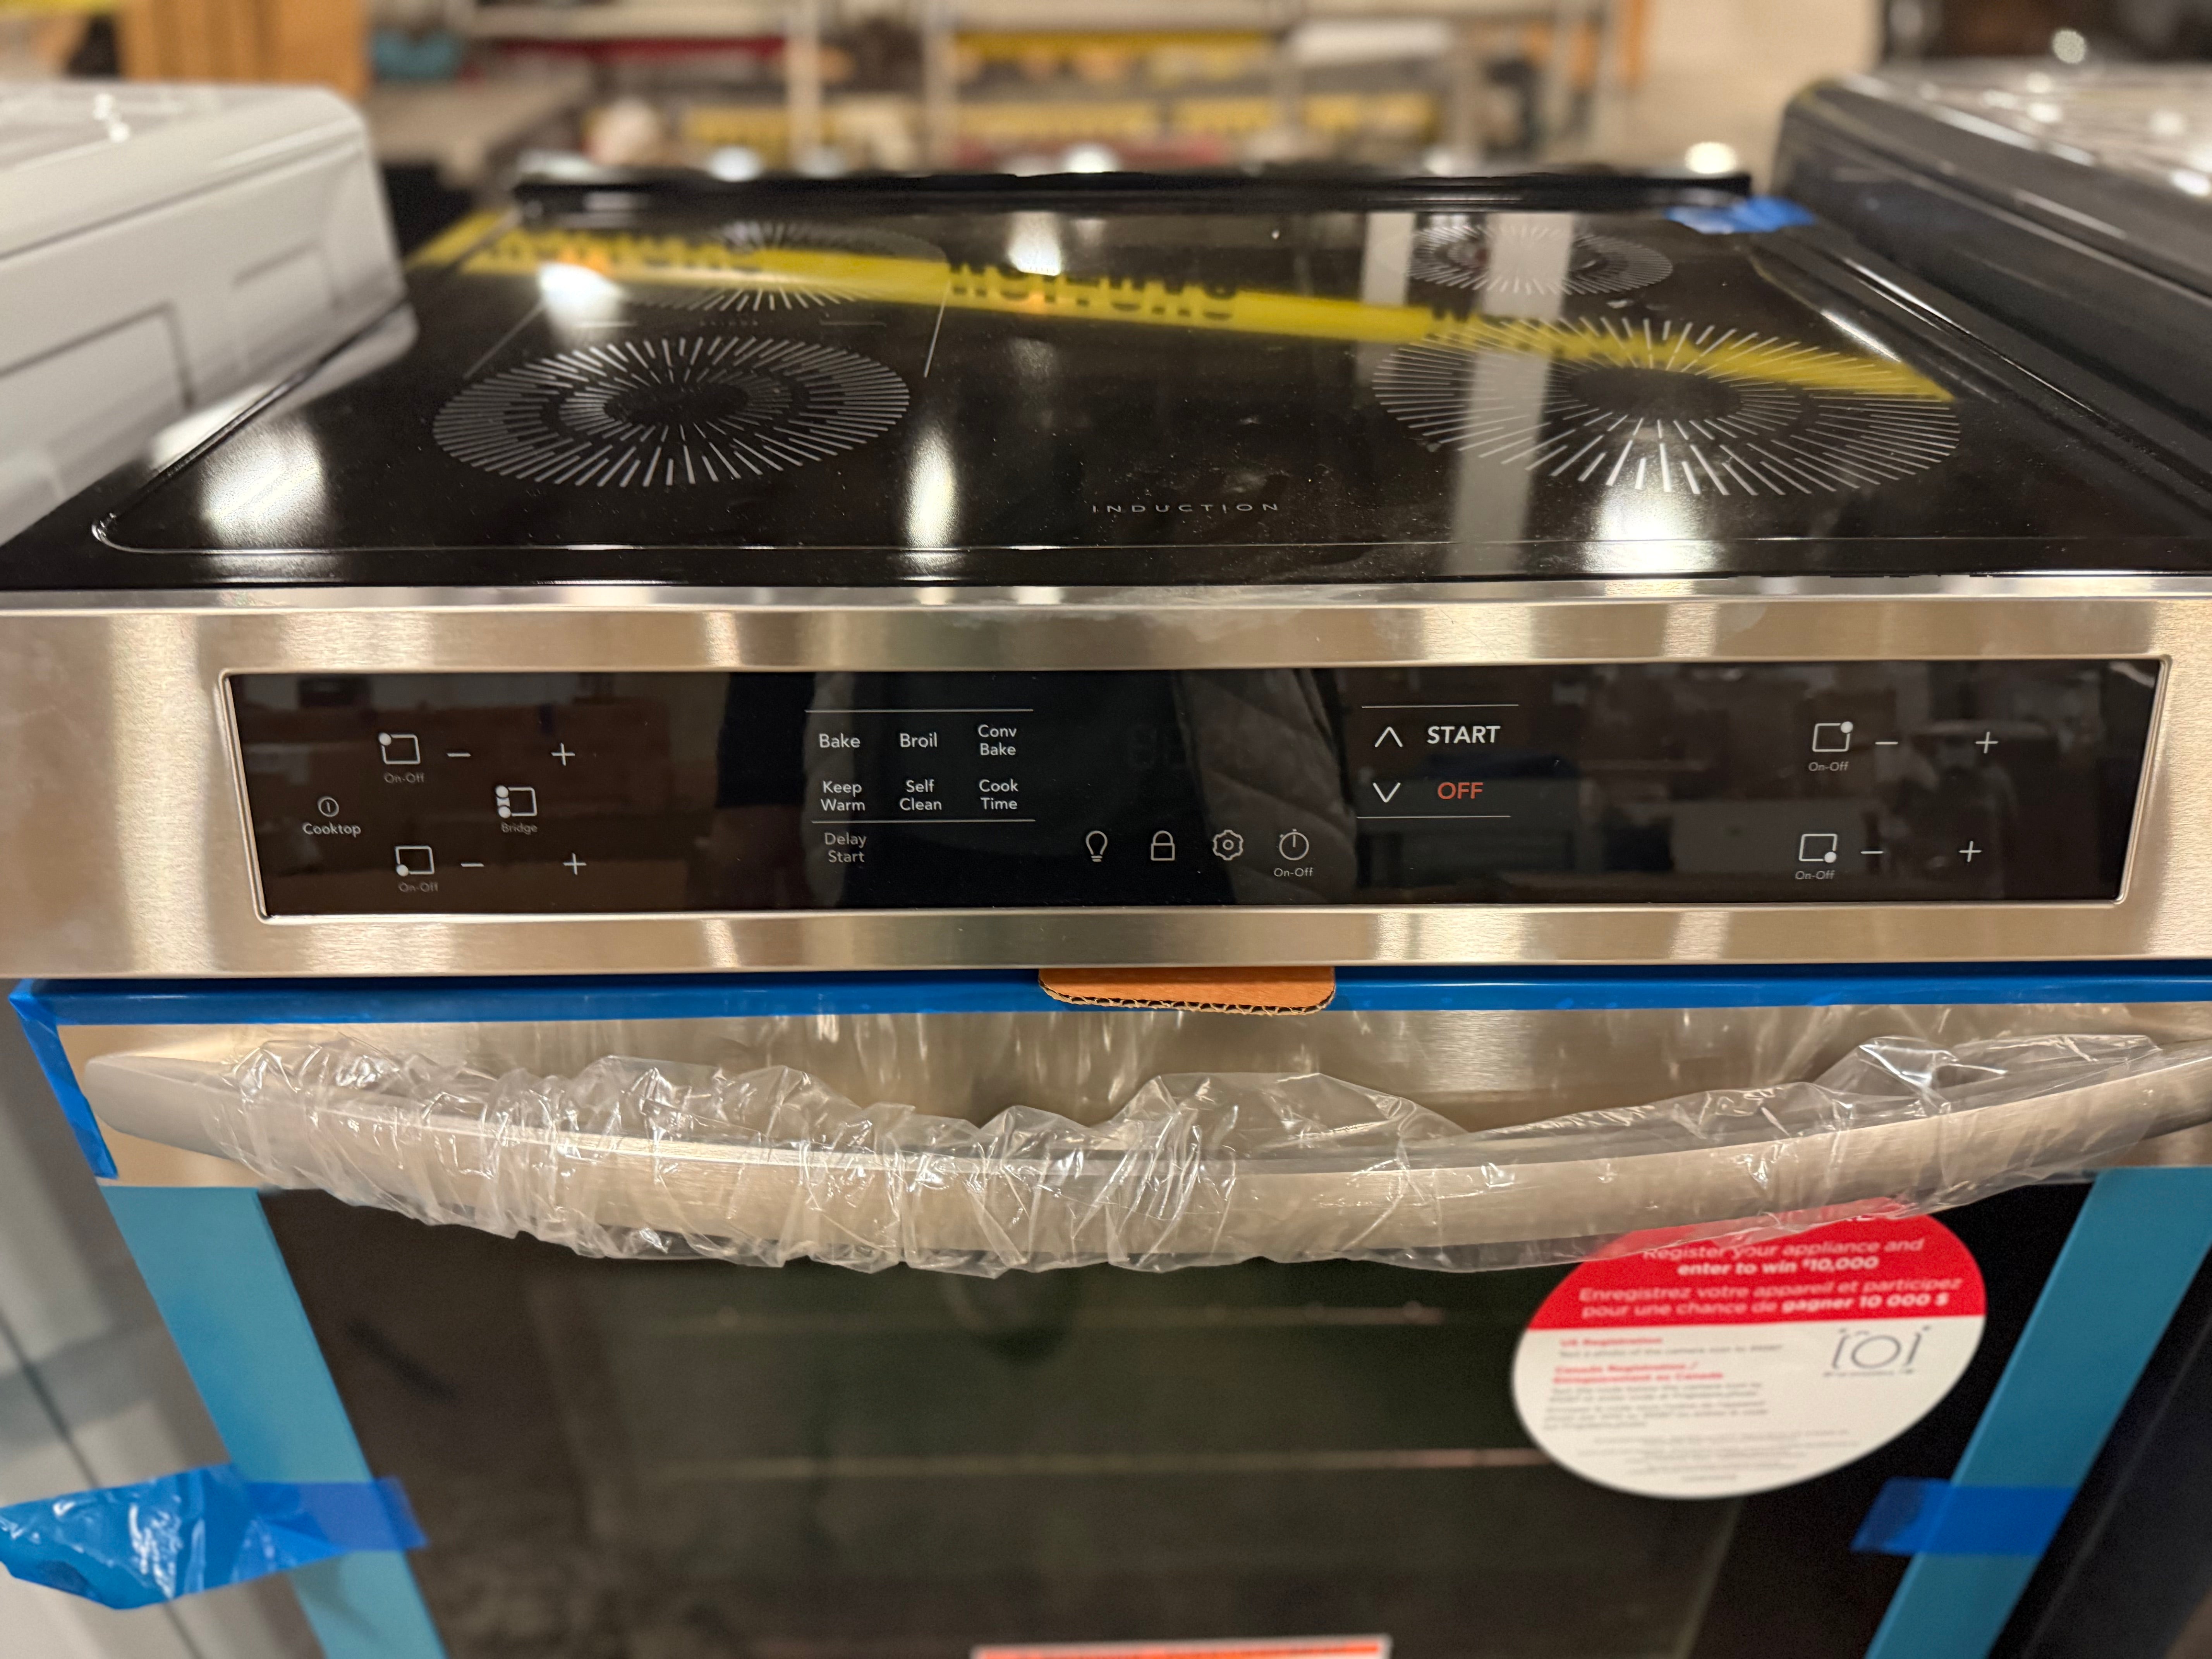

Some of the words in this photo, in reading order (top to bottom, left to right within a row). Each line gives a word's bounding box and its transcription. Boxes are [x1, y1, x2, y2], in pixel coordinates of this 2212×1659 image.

[1092, 503, 1278, 514] INDUCTION
[977, 724, 1017, 737] Conv
[1427, 725, 1501, 744] START
[819, 733, 861, 748] Bake
[900, 732, 938, 748] Broil
[980, 742, 1016, 756] Bake
[1808, 761, 1849, 772] On-Off
[384, 772, 425, 784] On-Off
[979, 778, 1018, 792] Cook
[823, 780, 862, 797] Keep
[905, 778, 935, 793] Self
[1437, 782, 1484, 800] OFF
[820, 798, 866, 812] Warm
[899, 797, 942, 811] Clean
[981, 797, 1018, 810] Time
[302, 822, 361, 838] Cooktop
[501, 823, 538, 835] Bridge
[824, 832, 867, 848] Delay
[828, 850, 865, 863] Start
[1273, 867, 1314, 878] On-Off
[1795, 870, 1835, 880] On-Off
[398, 882, 438, 893] On-Off
[1731, 1245, 1780, 1259] your
[1783, 1241, 1880, 1256] appliance
[1884, 1238, 1925, 1252] and
[1677, 1263, 1731, 1276] enter
[1735, 1262, 1757, 1275] to
[1762, 1261, 1797, 1274] win
[1579, 1287, 1691, 1302] Enregistrez
[1697, 1286, 1750, 1298] votre
[1753, 1281, 1834, 1297] appareil
[1837, 1281, 1858, 1293] et
[1862, 1278, 1963, 1293] participez
[1581, 1305, 1629, 1317] pour
[1634, 1304, 1672, 1316] une
[1676, 1302, 1747, 1314] chance
[1751, 1300, 1778, 1313] de
[1781, 1297, 1854, 1314] gagner
[1859, 1294, 1882, 1308] 10
[1886, 1293, 1931, 1307] 000
[1935, 1291, 1949, 1307] $
